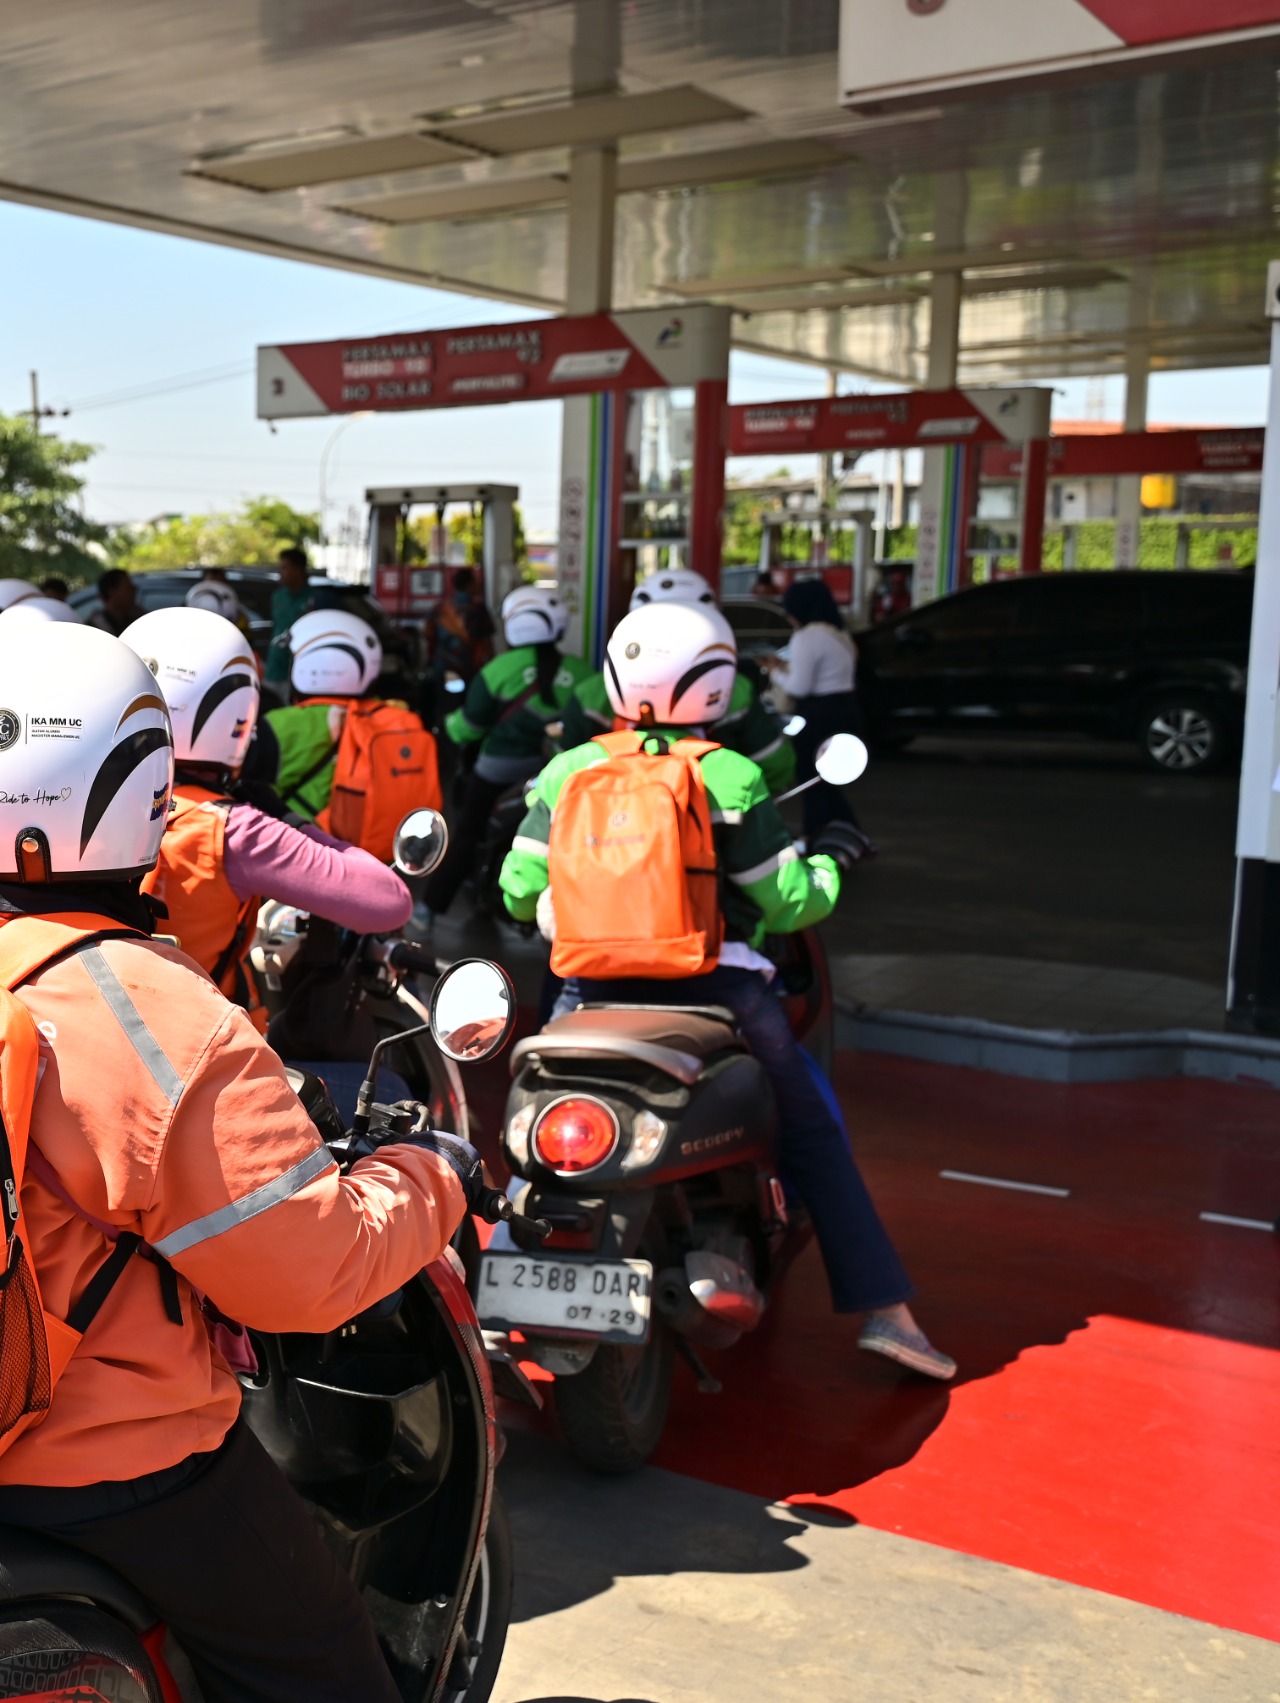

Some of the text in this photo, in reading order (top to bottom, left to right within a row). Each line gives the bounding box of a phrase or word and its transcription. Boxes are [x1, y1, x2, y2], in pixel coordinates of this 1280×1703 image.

[447, 330, 541, 354] PERTAMAX
[341, 380, 431, 400] BIO SOLAR
[31, 717, 82, 727] IKA MM UC
[18, 793, 30, 804] to
[33, 788, 61, 806] Hope
[486, 1261, 641, 1298] L 2588 DAR
